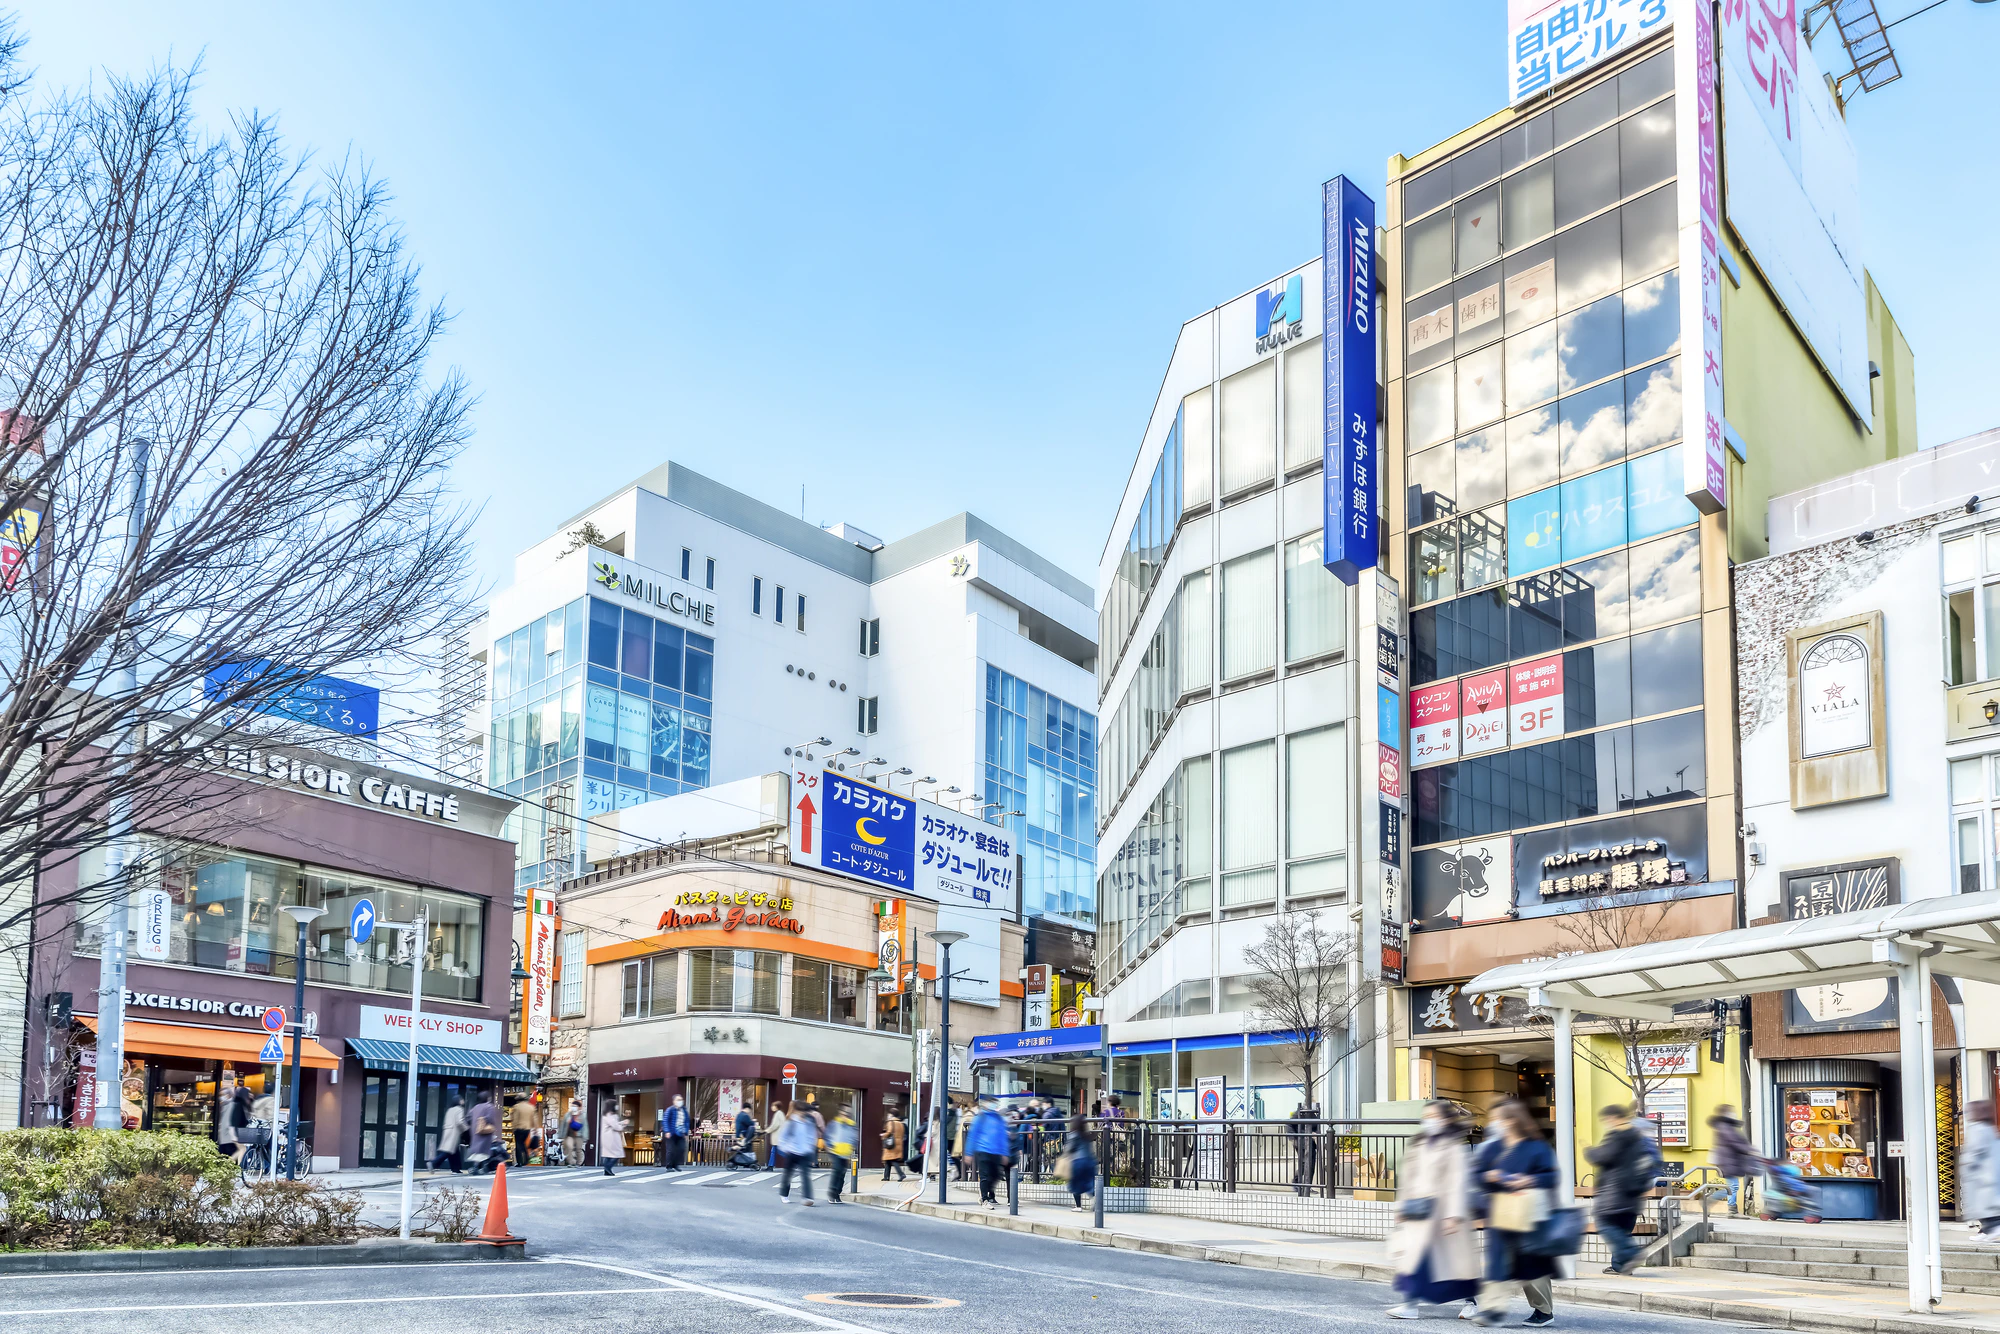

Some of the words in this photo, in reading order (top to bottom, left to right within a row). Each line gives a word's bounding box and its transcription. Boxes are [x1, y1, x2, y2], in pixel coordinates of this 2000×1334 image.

[1355, 216, 1369, 334] MIZUHO
[1460, 293, 1498, 324] 歯科
[1256, 322, 1302, 354] HULIC
[1352, 412, 1368, 540] みずほ銀行
[1707, 463, 1723, 493] 3F
[1561, 483, 1672, 533] ハウスコム
[624, 573, 715, 626] MILCHE
[593, 697, 647, 718] CARDOBARRE
[1416, 691, 1451, 706] パソコン
[1416, 703, 1451, 718] スクール
[1811, 698, 1860, 714] VIALA
[1519, 707, 1554, 733] 3F
[1380, 745, 1399, 765] パソコン
[1417, 742, 1451, 757] スクール
[797, 771, 818, 788] スグ
[1380, 777, 1399, 797] アビバ
[360, 776, 459, 822] CAFFÉ
[833, 781, 907, 821] カラオケ
[922, 814, 1010, 858] カラオケ・宴会は
[832, 850, 907, 882] コート・ダジュール
[940, 879, 964, 893] ダジュール
[674, 890, 795, 912] パスタとピザの店
[151, 893, 163, 945] GREGG
[656, 907, 720, 931] Miami
[123, 989, 224, 1014] EXCELSIOR
[446, 1021, 484, 1036] SHOP
[980, 1041, 998, 1049] MIZUHO
[1017, 1036, 1053, 1047] みずほ銀行
